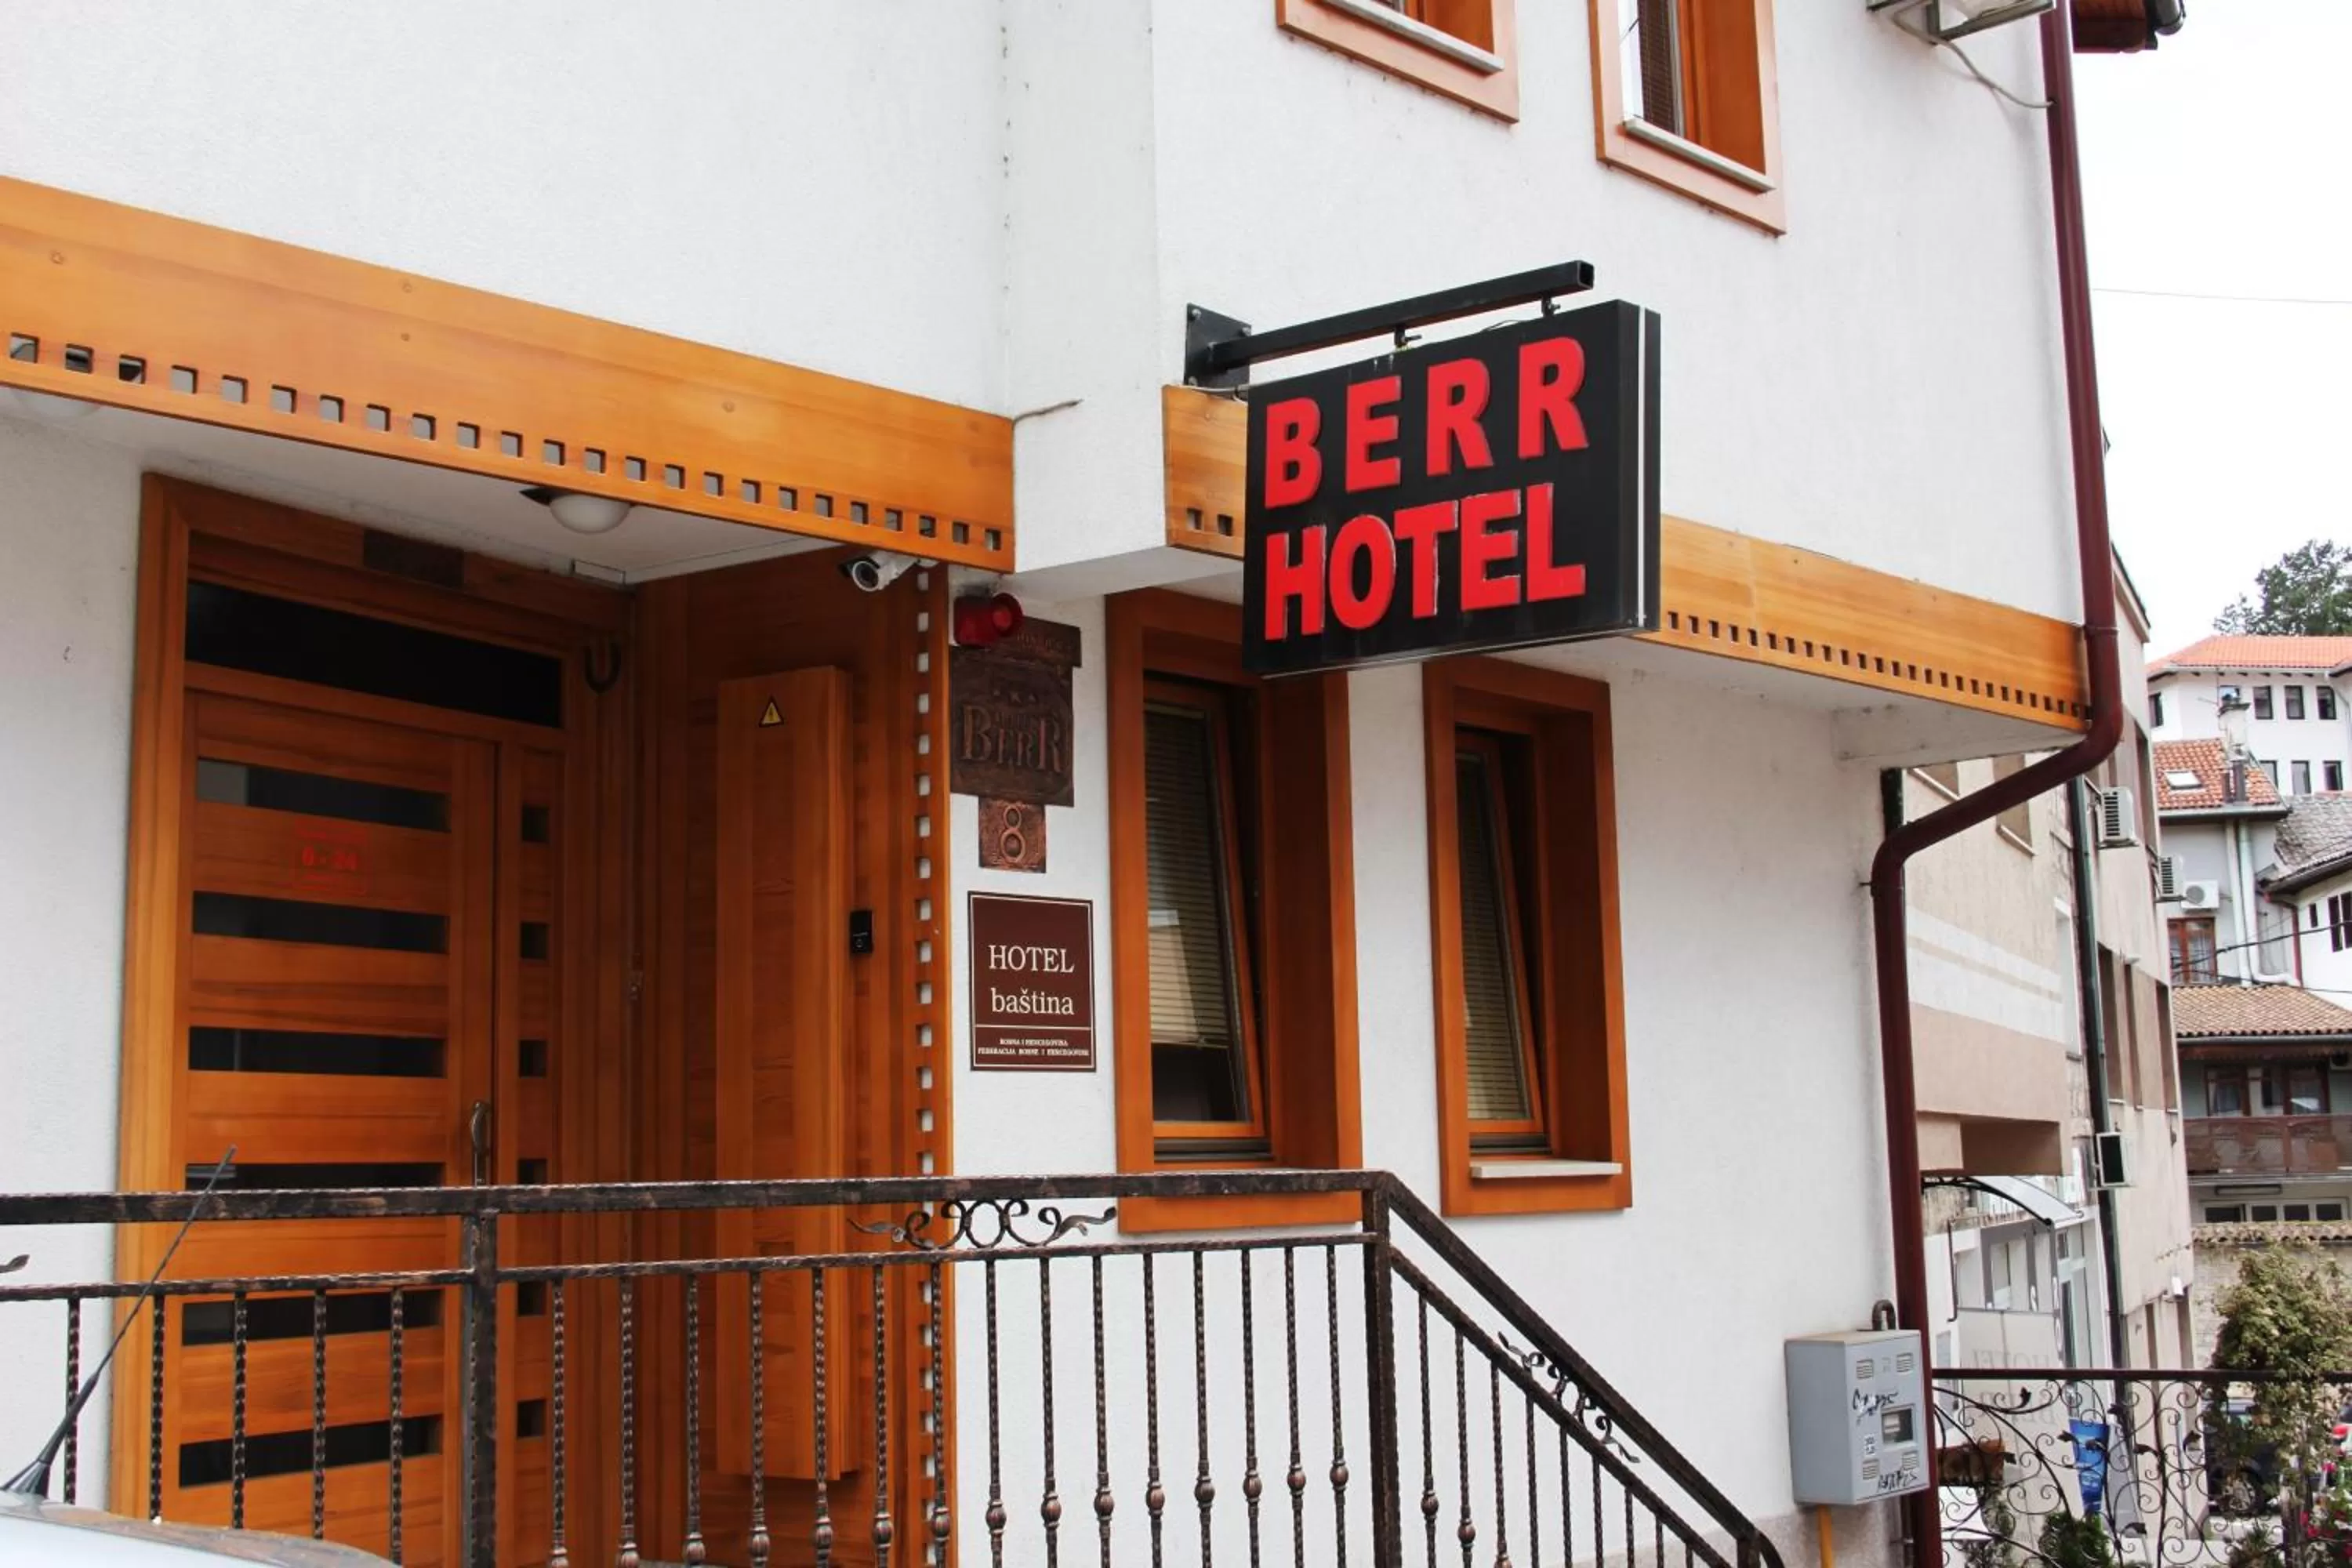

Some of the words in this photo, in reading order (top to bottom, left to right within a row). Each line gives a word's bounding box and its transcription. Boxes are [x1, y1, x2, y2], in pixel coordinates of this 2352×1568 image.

[1264, 336, 1589, 509] BERR
[1264, 482, 1587, 641] HOTEL
[1000, 804, 1026, 862] 8
[988, 944, 1075, 973] HOTEL
[989, 987, 1075, 1015] baština
